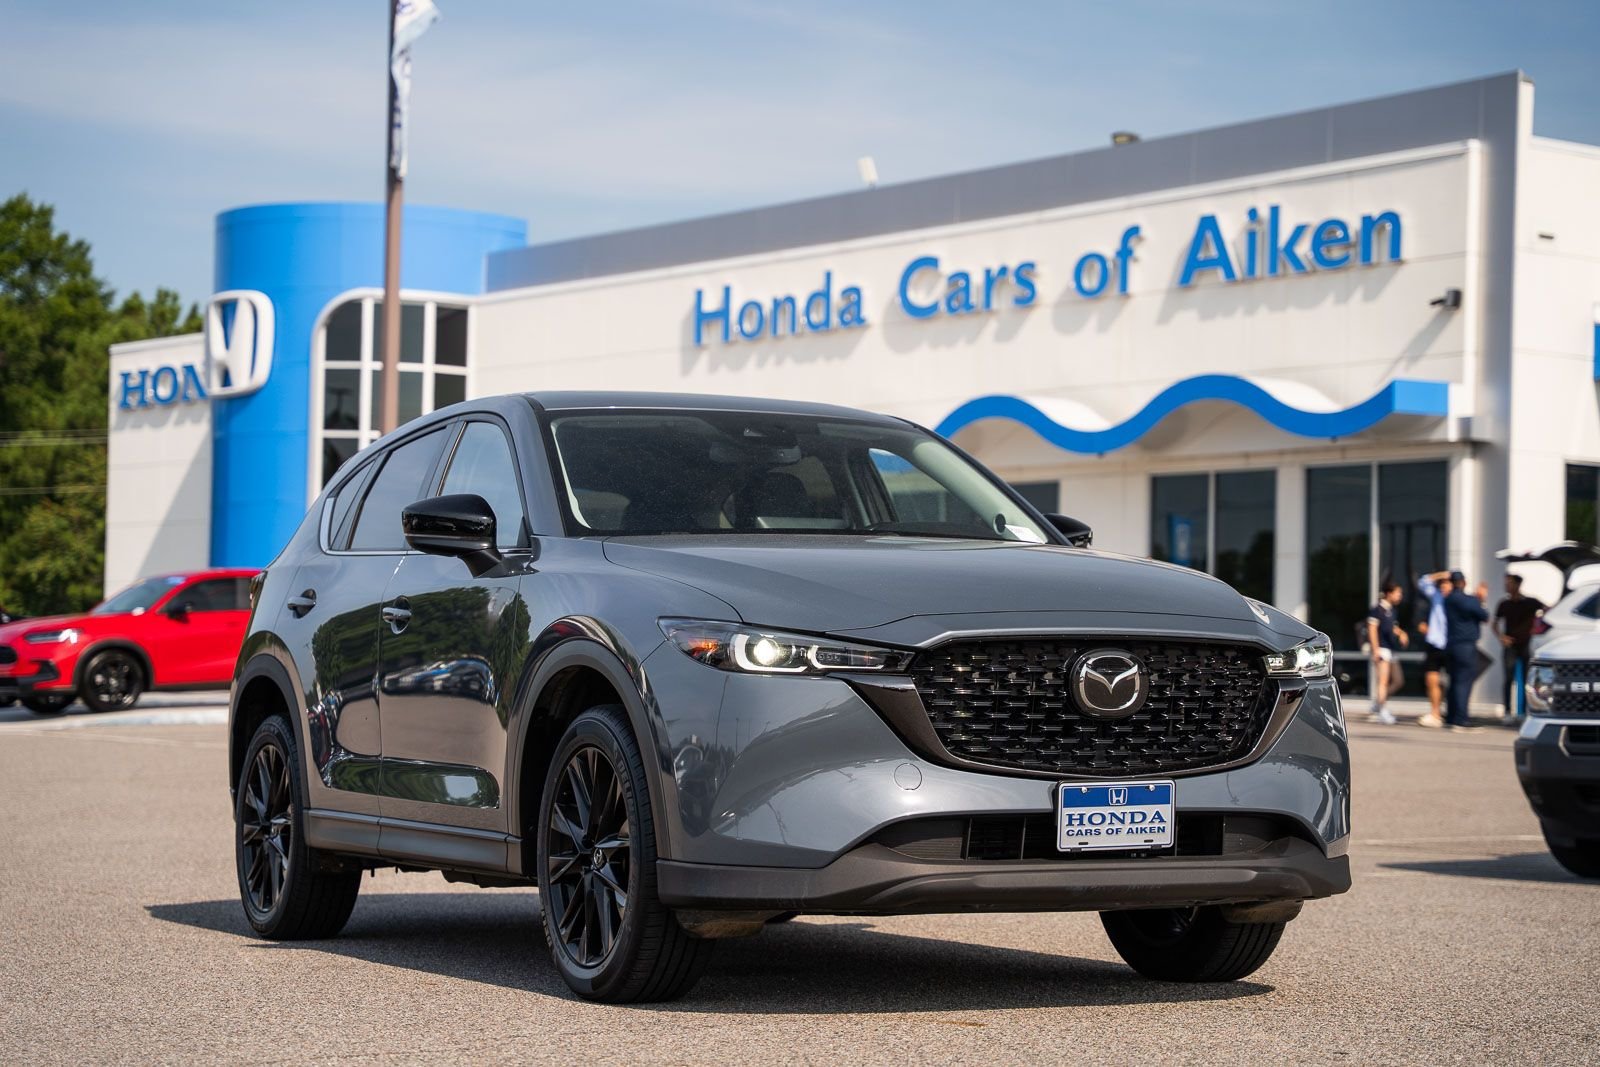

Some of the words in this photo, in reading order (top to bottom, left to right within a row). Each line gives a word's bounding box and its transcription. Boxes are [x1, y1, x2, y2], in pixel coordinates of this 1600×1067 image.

[694, 272, 865, 345] Honda
[899, 256, 1037, 319] Cars
[1073, 225, 1142, 298] of
[1178, 206, 1402, 286] Aiken
[1066, 810, 1167, 827] HONDA
[1066, 828, 1102, 837] CARS
[1105, 827, 1122, 836] OF
[1126, 826, 1166, 835] AIKEN
